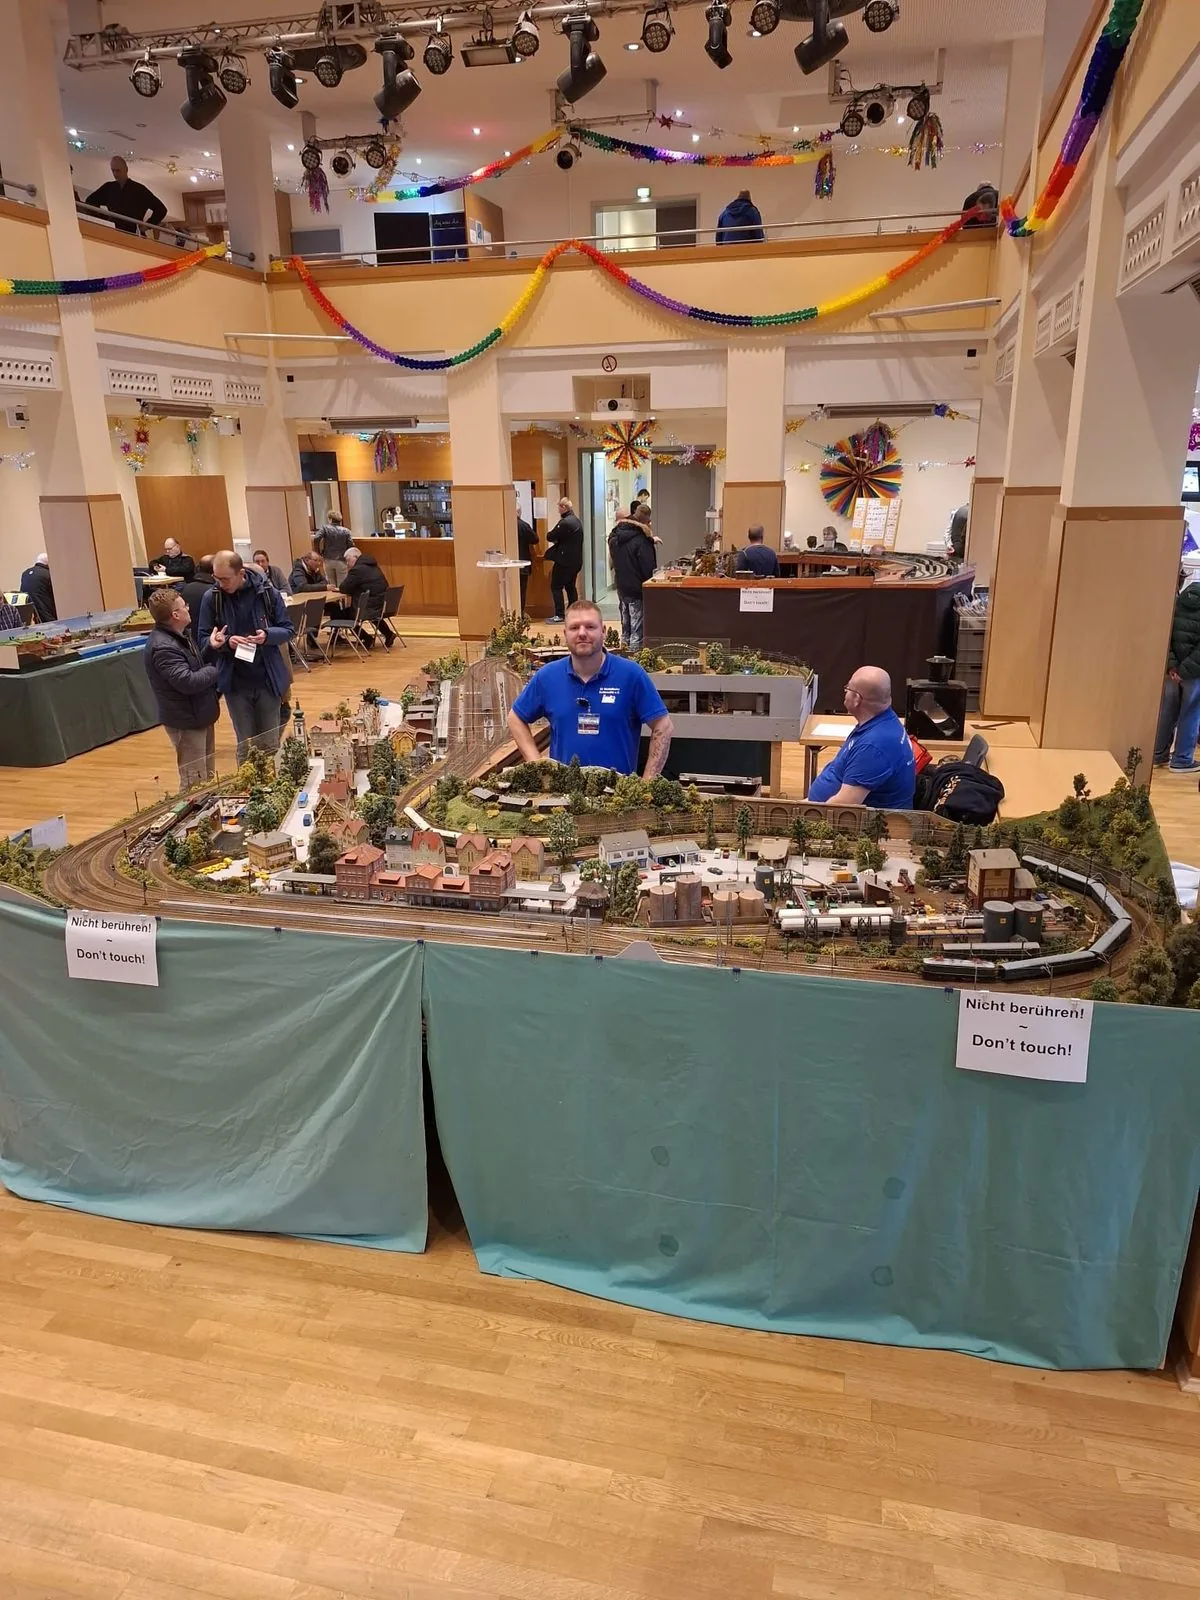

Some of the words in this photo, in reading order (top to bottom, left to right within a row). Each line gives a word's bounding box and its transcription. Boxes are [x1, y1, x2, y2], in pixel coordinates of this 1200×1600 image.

[71, 916, 99, 929] Nicht
[101, 919, 152, 934] berühren!
[76, 948, 107, 961] Don't
[109, 952, 146, 965] touch!
[965, 998, 1006, 1012] Nicht
[1009, 1001, 1085, 1019] berühren!
[972, 1034, 1016, 1051] Don't
[1020, 1040, 1073, 1056] touch!
